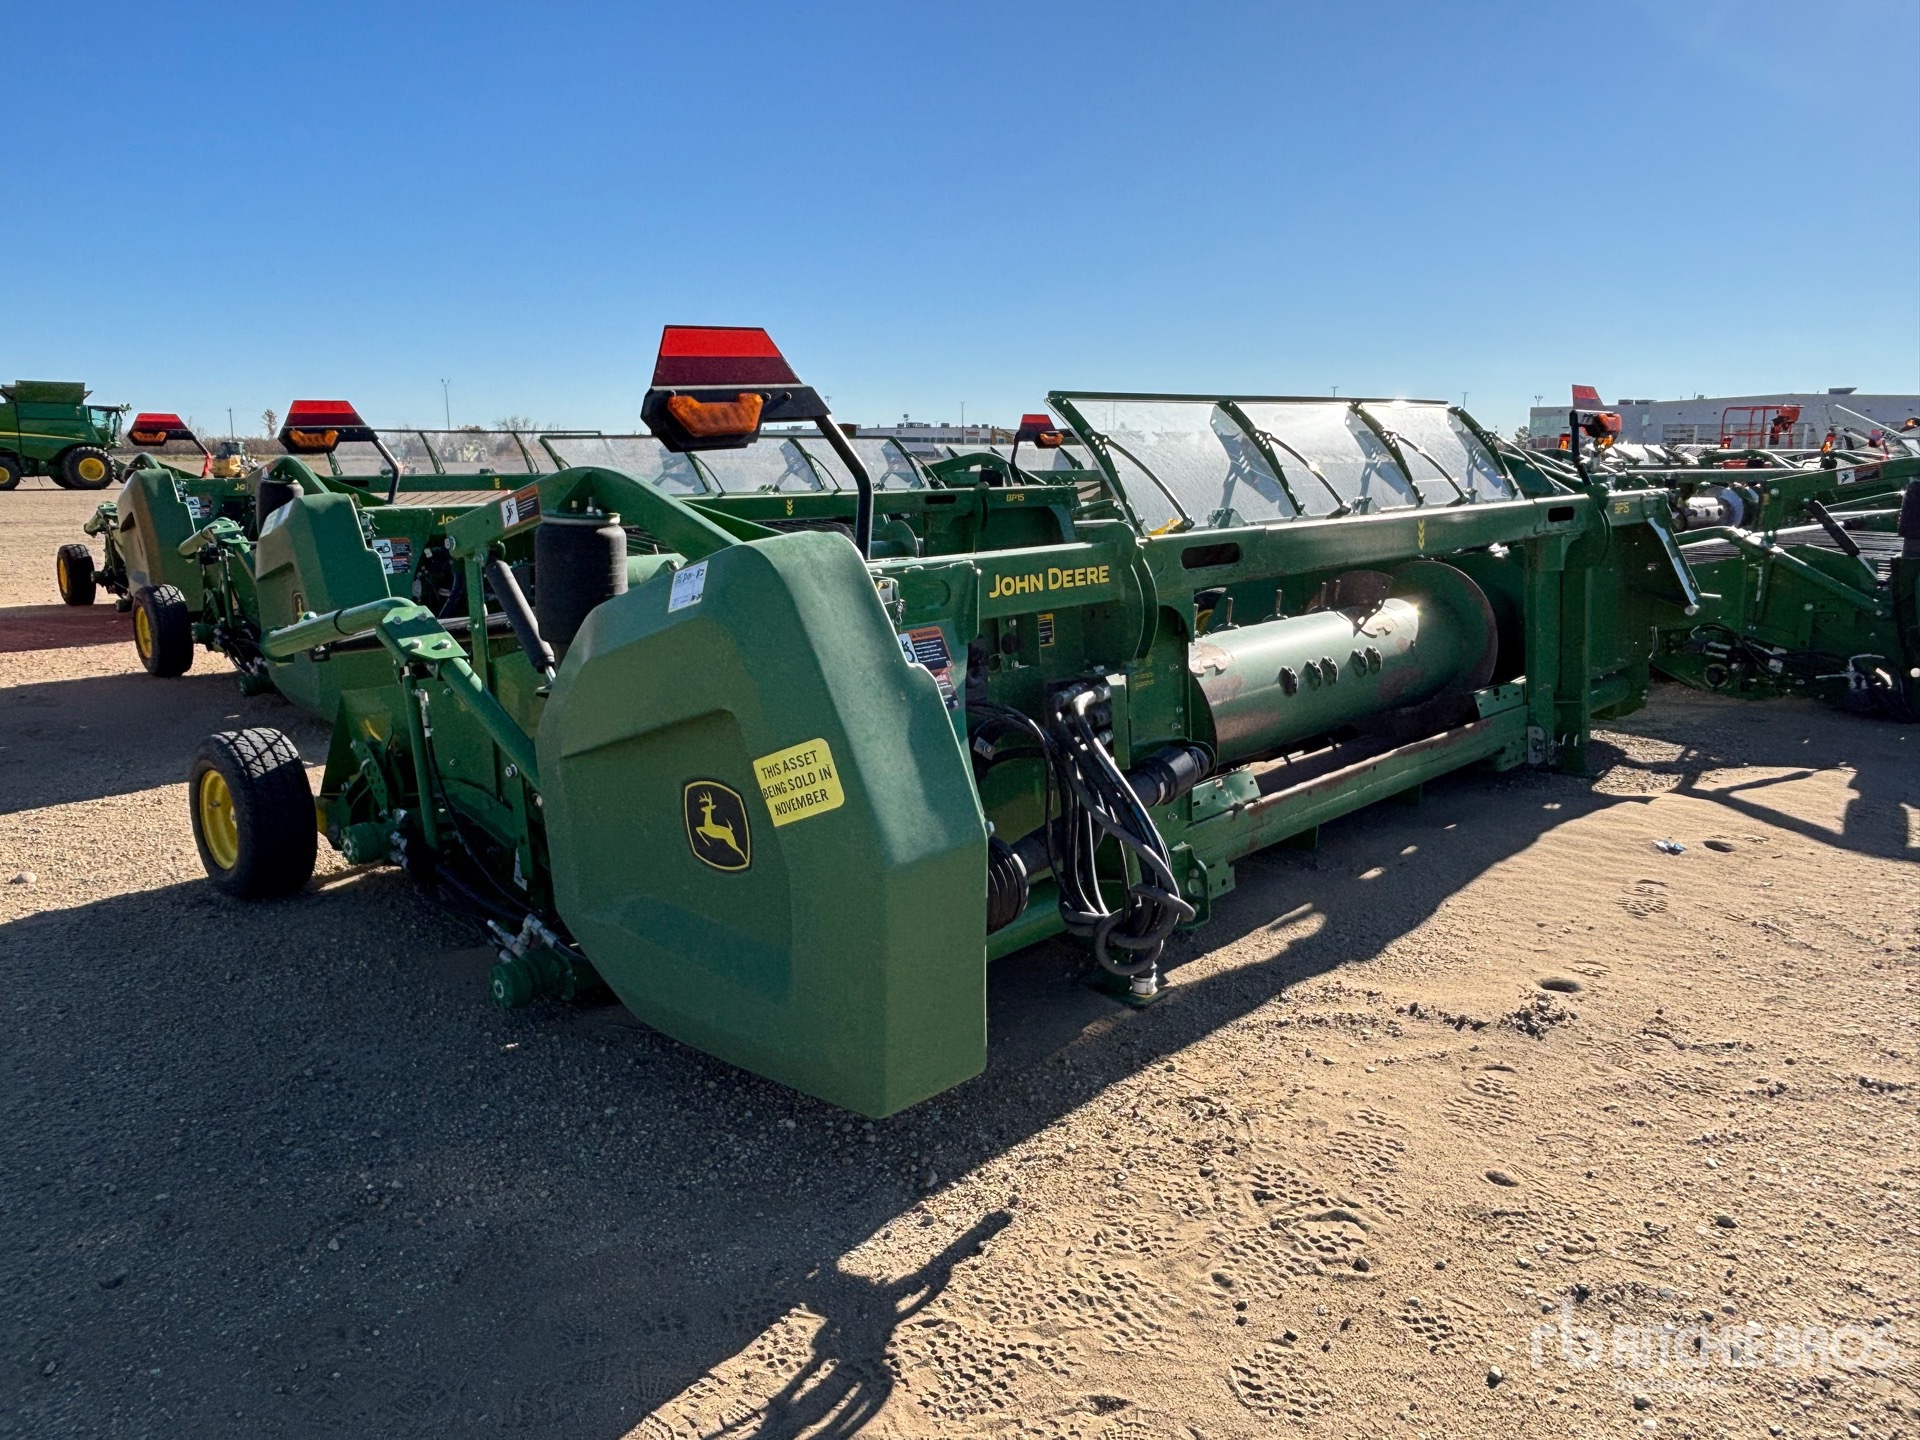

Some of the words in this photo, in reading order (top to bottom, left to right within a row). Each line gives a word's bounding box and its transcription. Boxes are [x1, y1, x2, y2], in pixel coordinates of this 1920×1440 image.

[989, 573, 1044, 598] JOHN
[1047, 565, 1110, 590] DEERE
[761, 763, 782, 780] THIS
[783, 750, 818, 773] ASSET
[762, 781, 788, 800] BEING
[787, 771, 817, 791] SOLD
[818, 766, 833, 781] IN
[774, 788, 829, 816] NOVEMBER
